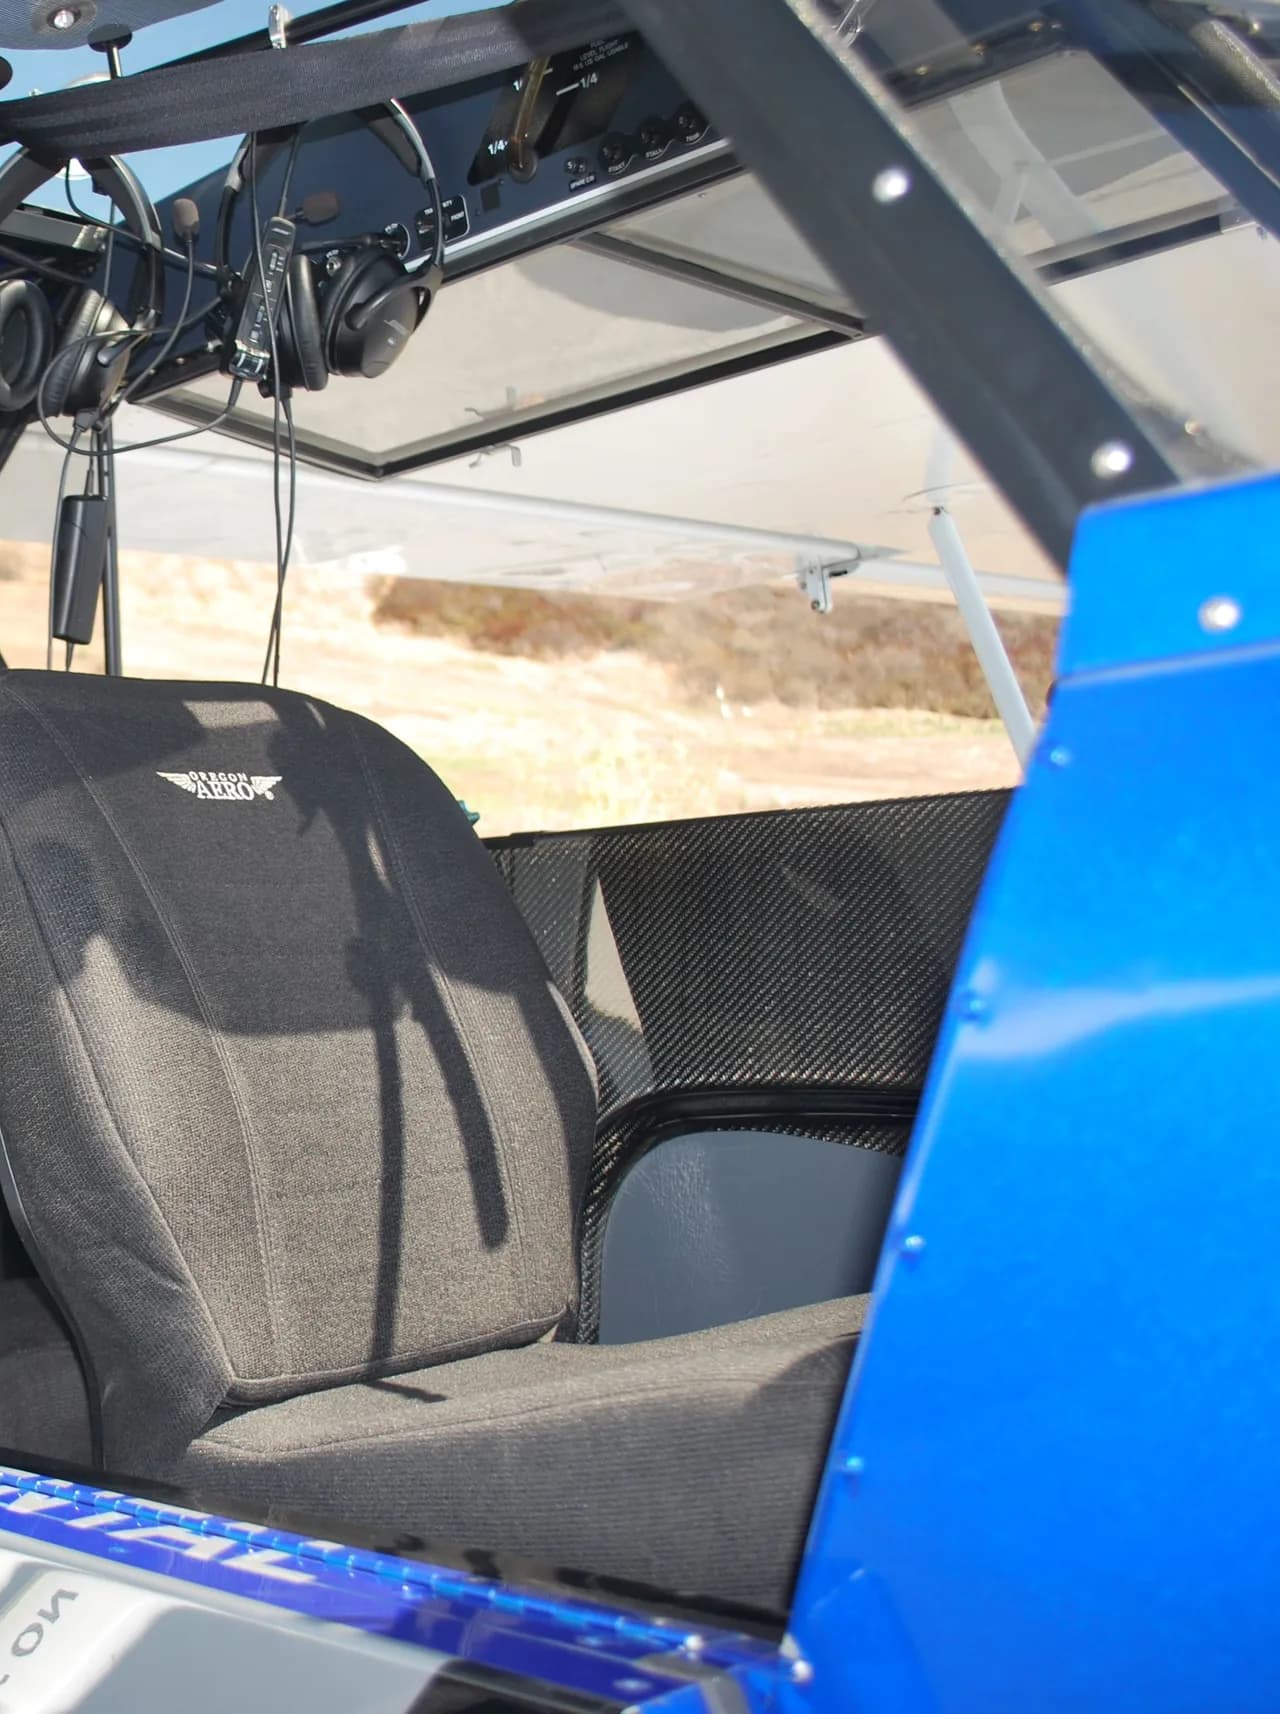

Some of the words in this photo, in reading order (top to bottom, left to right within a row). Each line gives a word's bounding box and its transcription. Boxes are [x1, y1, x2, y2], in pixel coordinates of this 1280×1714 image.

[513, 78, 523, 91] 1/
[580, 72, 598, 88] 1/4
[487, 139, 506, 155] 1/4
[188, 771, 249, 782] OREGON
[196, 780, 255, 800] AERO
